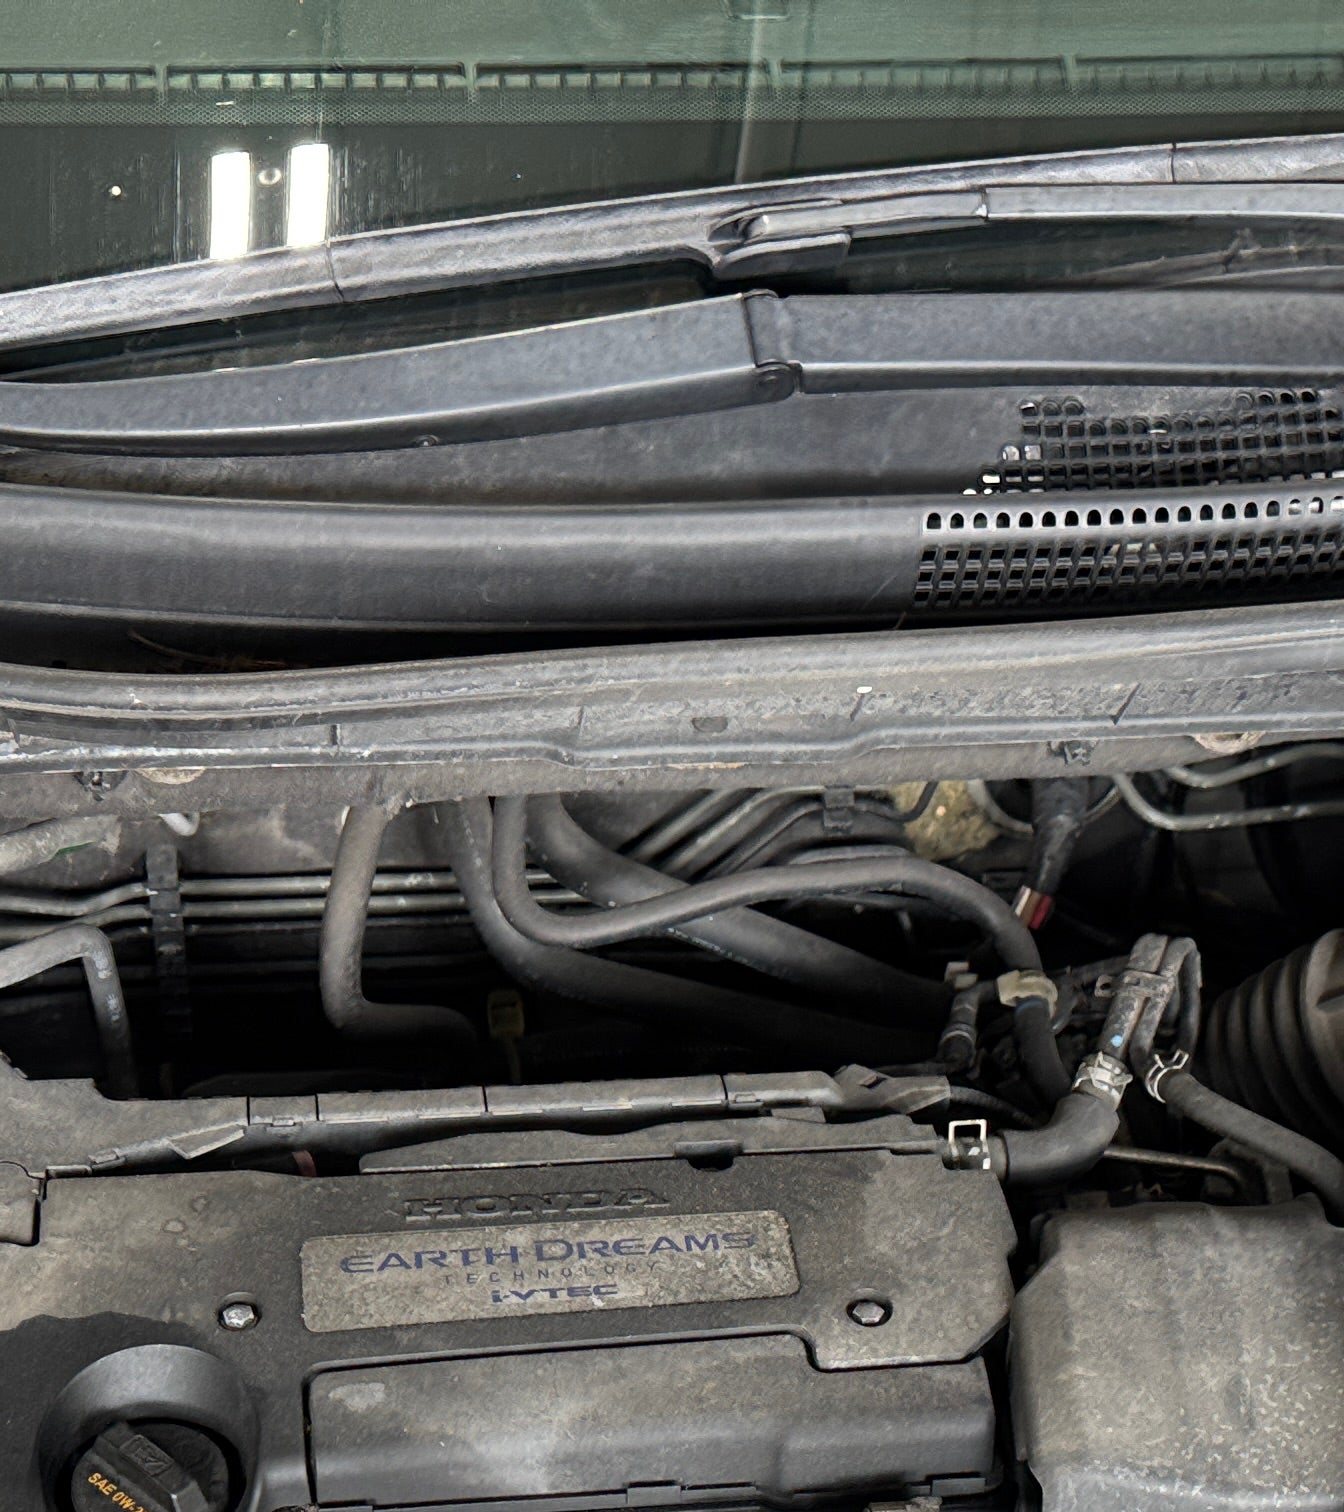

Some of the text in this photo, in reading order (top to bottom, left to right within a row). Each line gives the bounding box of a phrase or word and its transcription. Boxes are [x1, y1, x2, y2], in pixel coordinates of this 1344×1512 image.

[404, 1187, 671, 1222] HONDA
[340, 1231, 757, 1274] EARTH DREAMS
[442, 1262, 657, 1285] TECHNOLOGY
[88, 1472, 118, 1496] SAE
